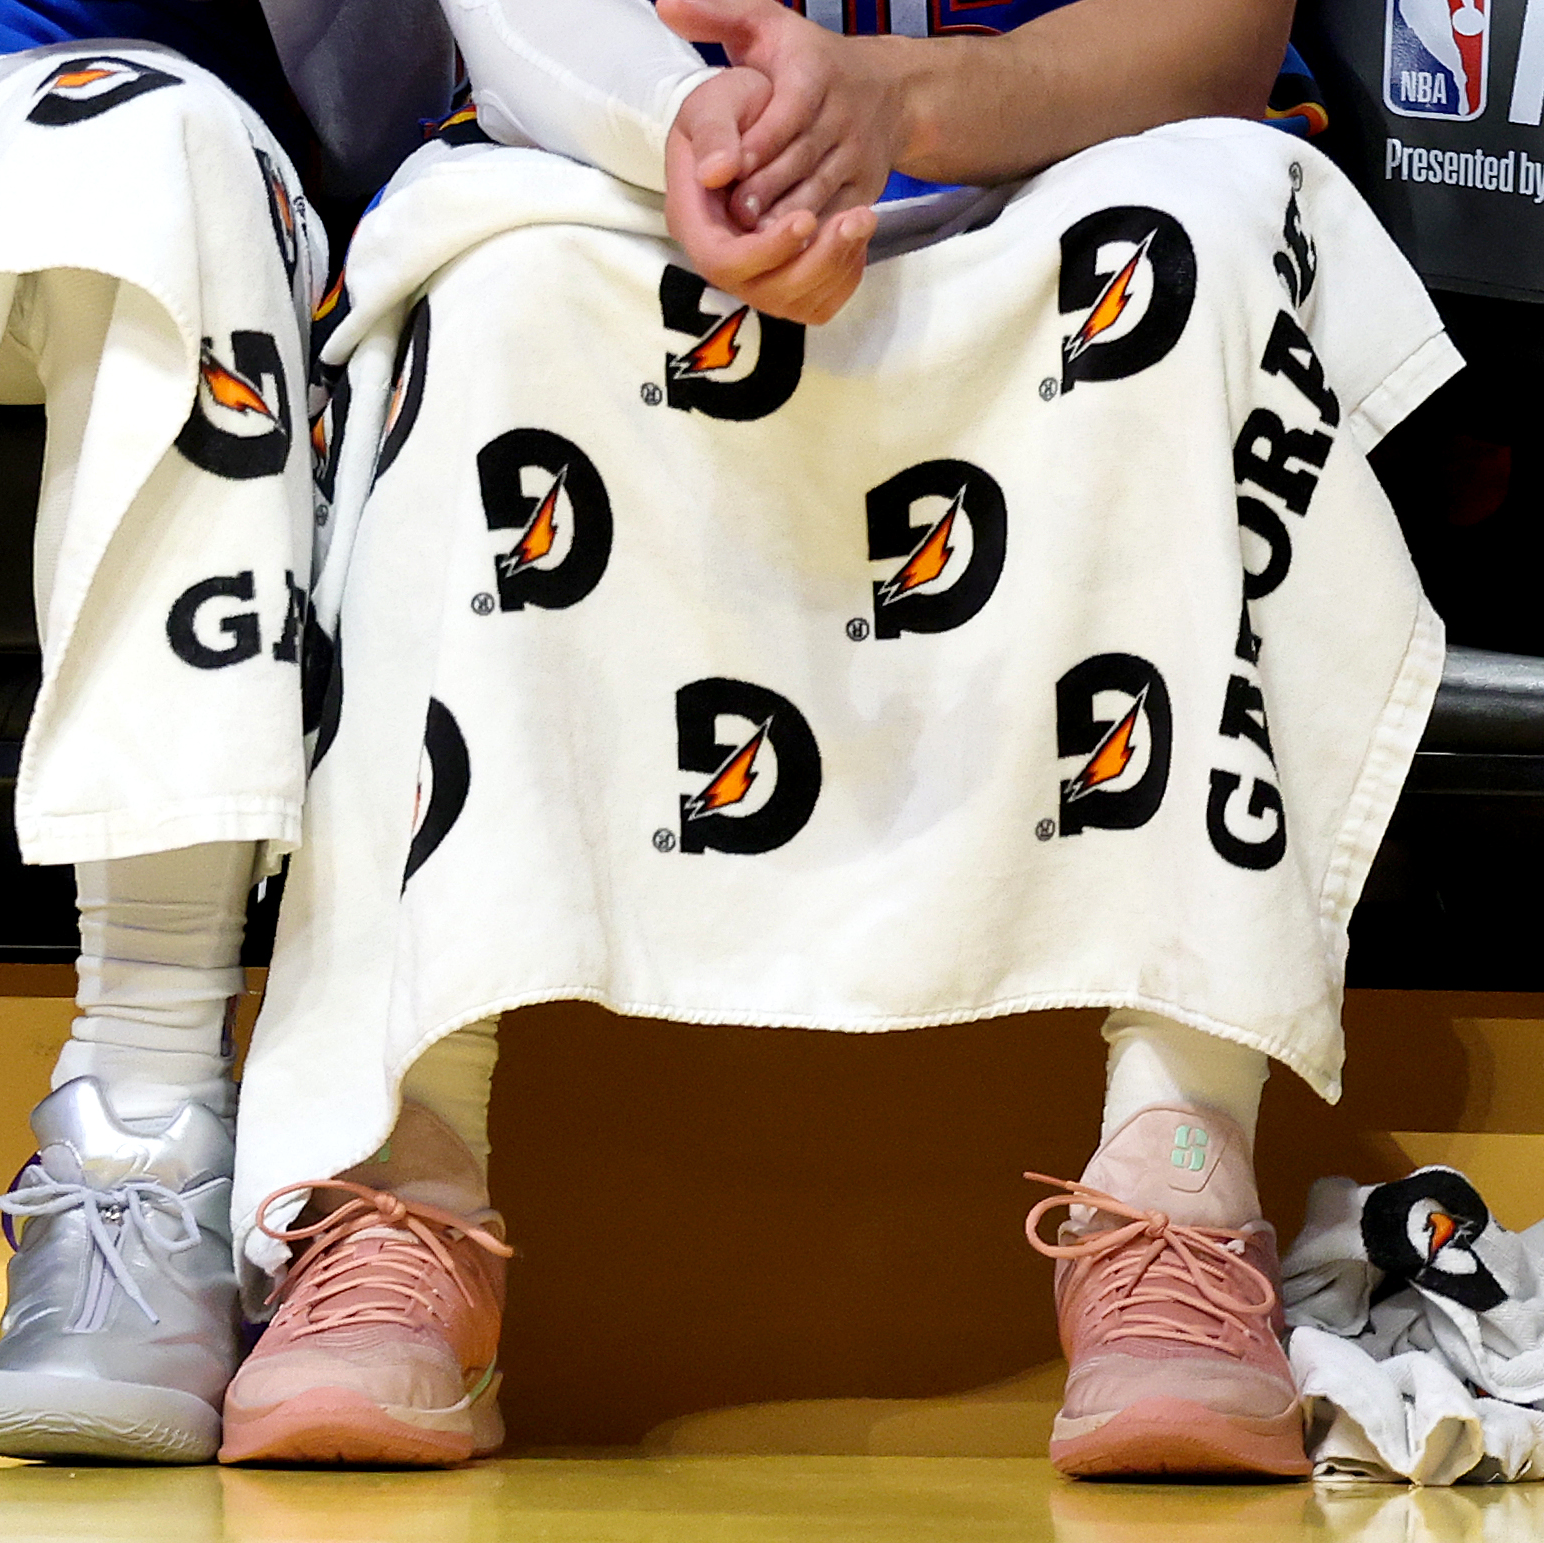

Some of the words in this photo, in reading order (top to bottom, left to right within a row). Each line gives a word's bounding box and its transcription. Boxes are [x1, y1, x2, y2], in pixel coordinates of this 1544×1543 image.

[1399, 71, 1448, 105] NBA
[1384, 137, 1516, 194] Presented
[1518, 151, 1544, 205] by
